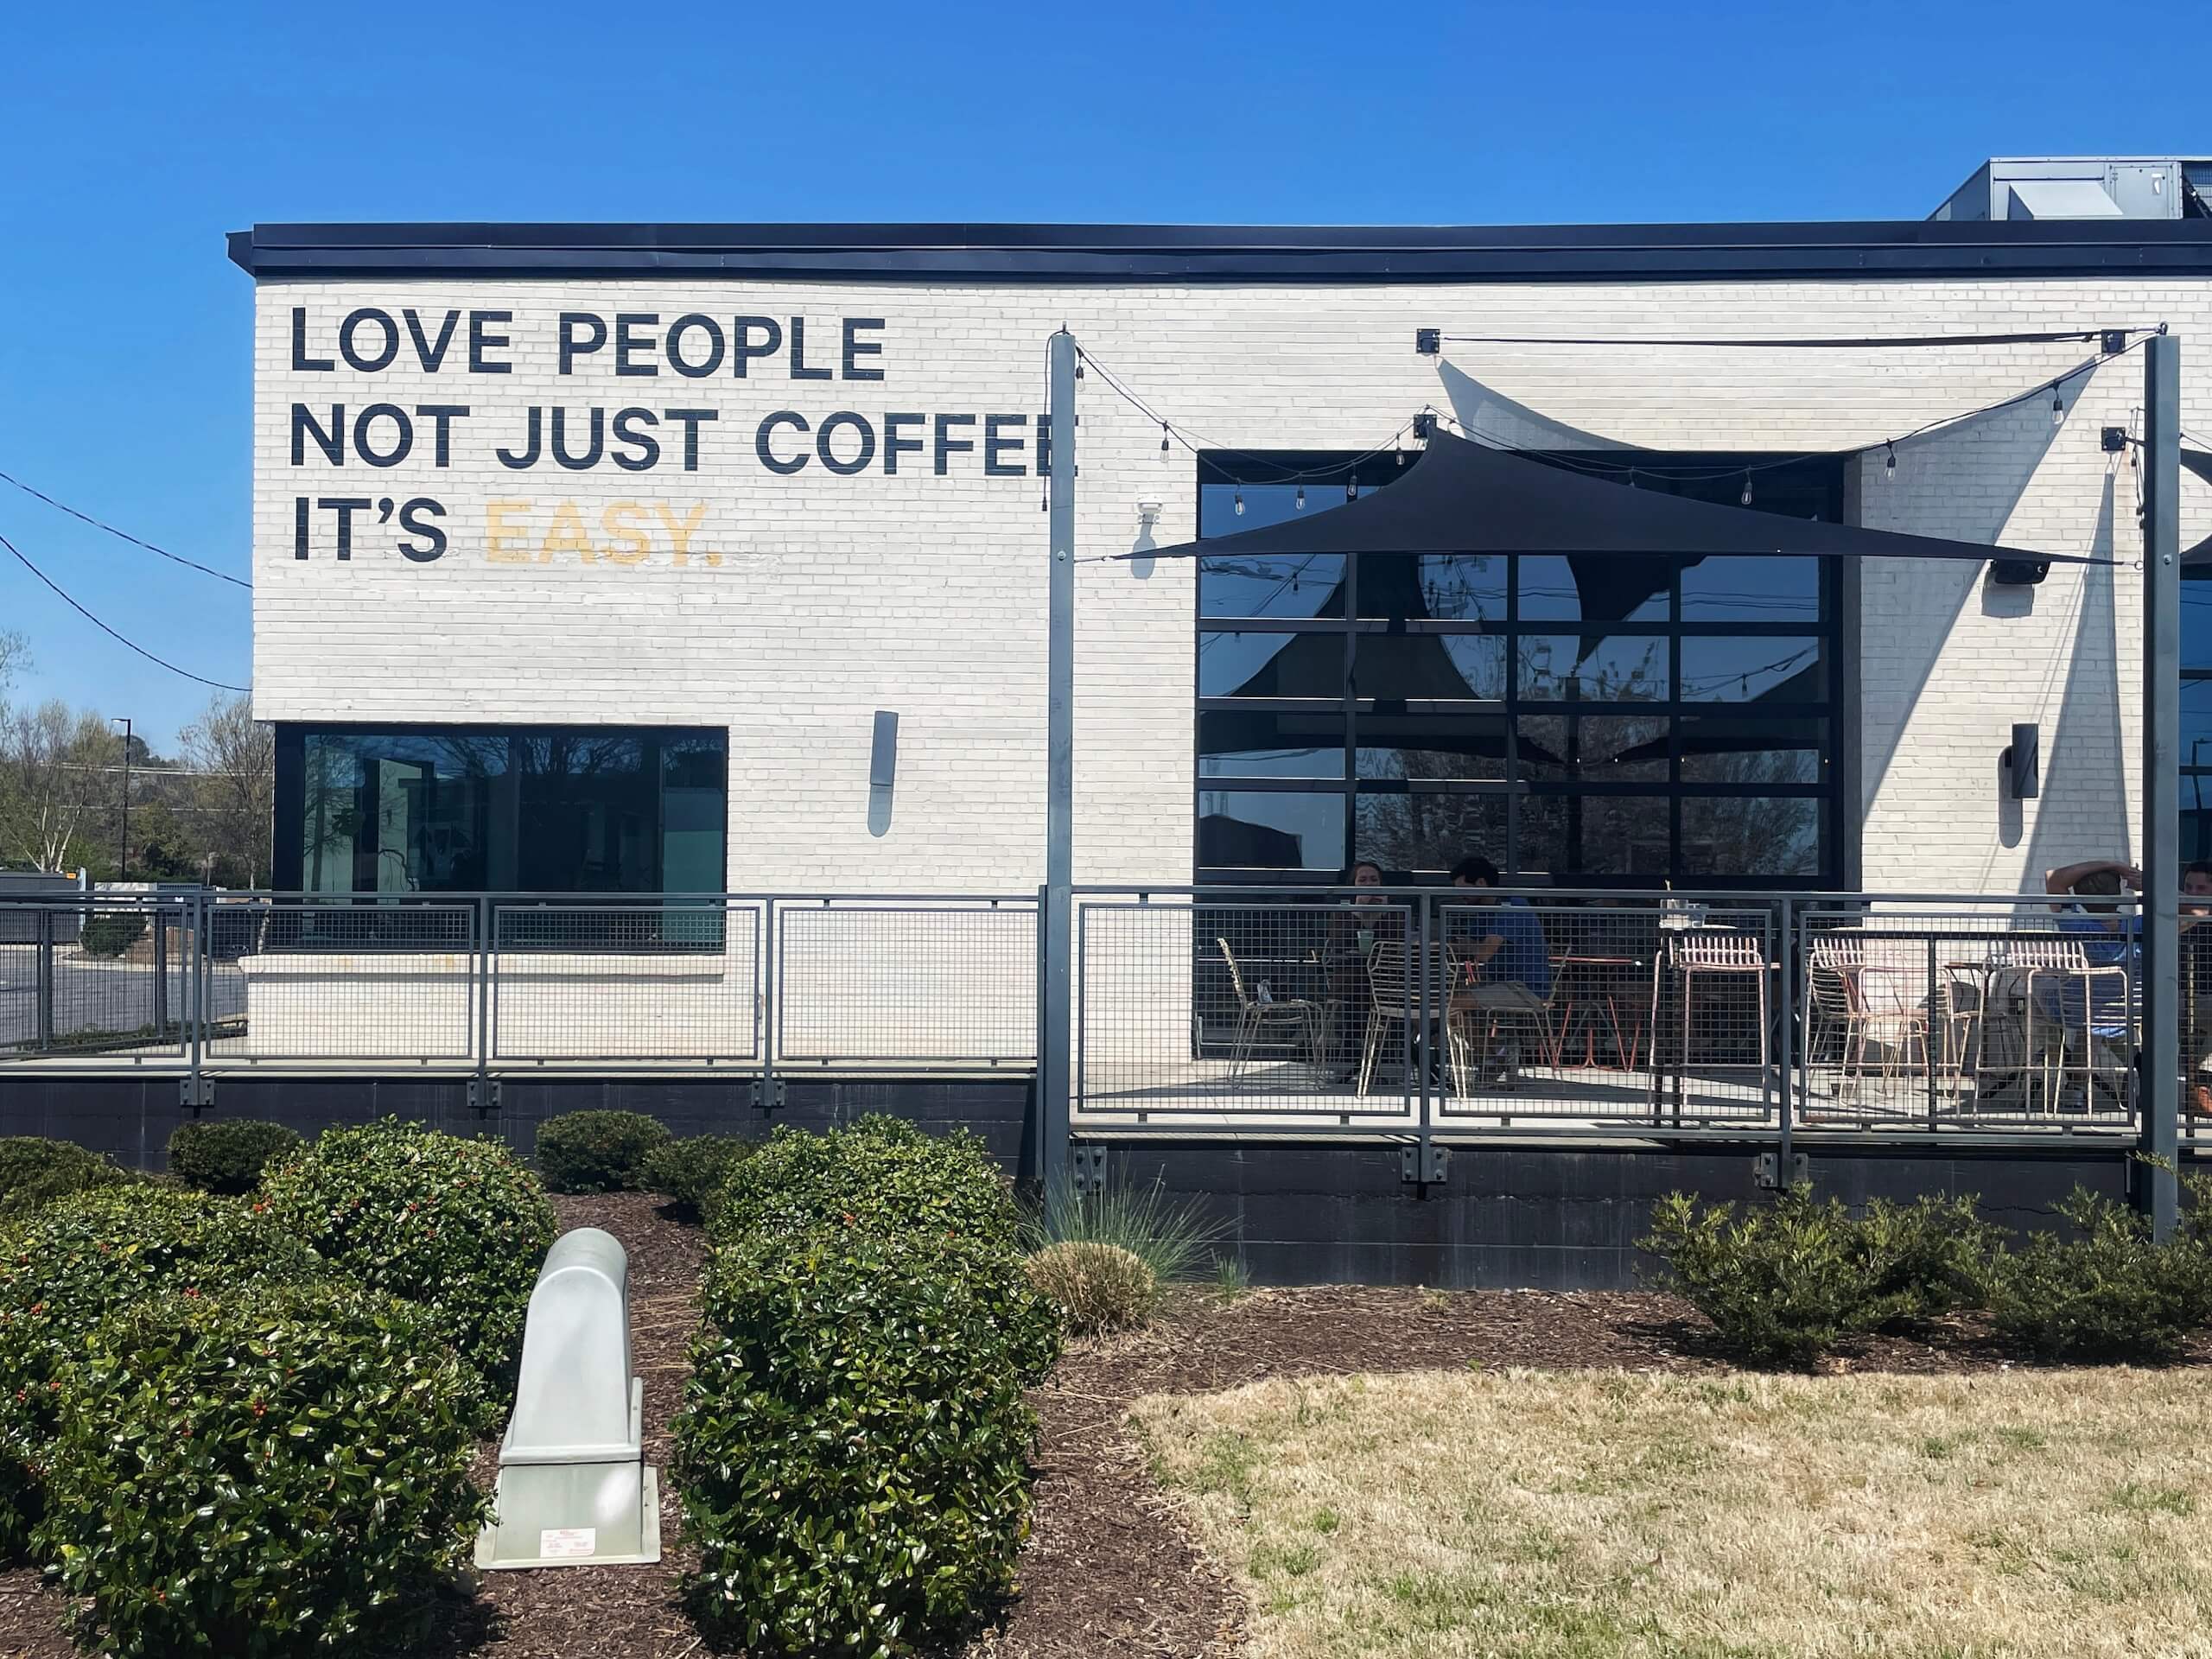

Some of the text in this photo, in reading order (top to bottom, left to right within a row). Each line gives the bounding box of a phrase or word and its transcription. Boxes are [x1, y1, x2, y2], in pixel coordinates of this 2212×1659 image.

[292, 308, 886, 380] LOVE PEOPLE
[291, 404, 470, 467] NOT
[496, 406, 718, 471] JUST
[296, 497, 722, 567] IT’S EASY.
